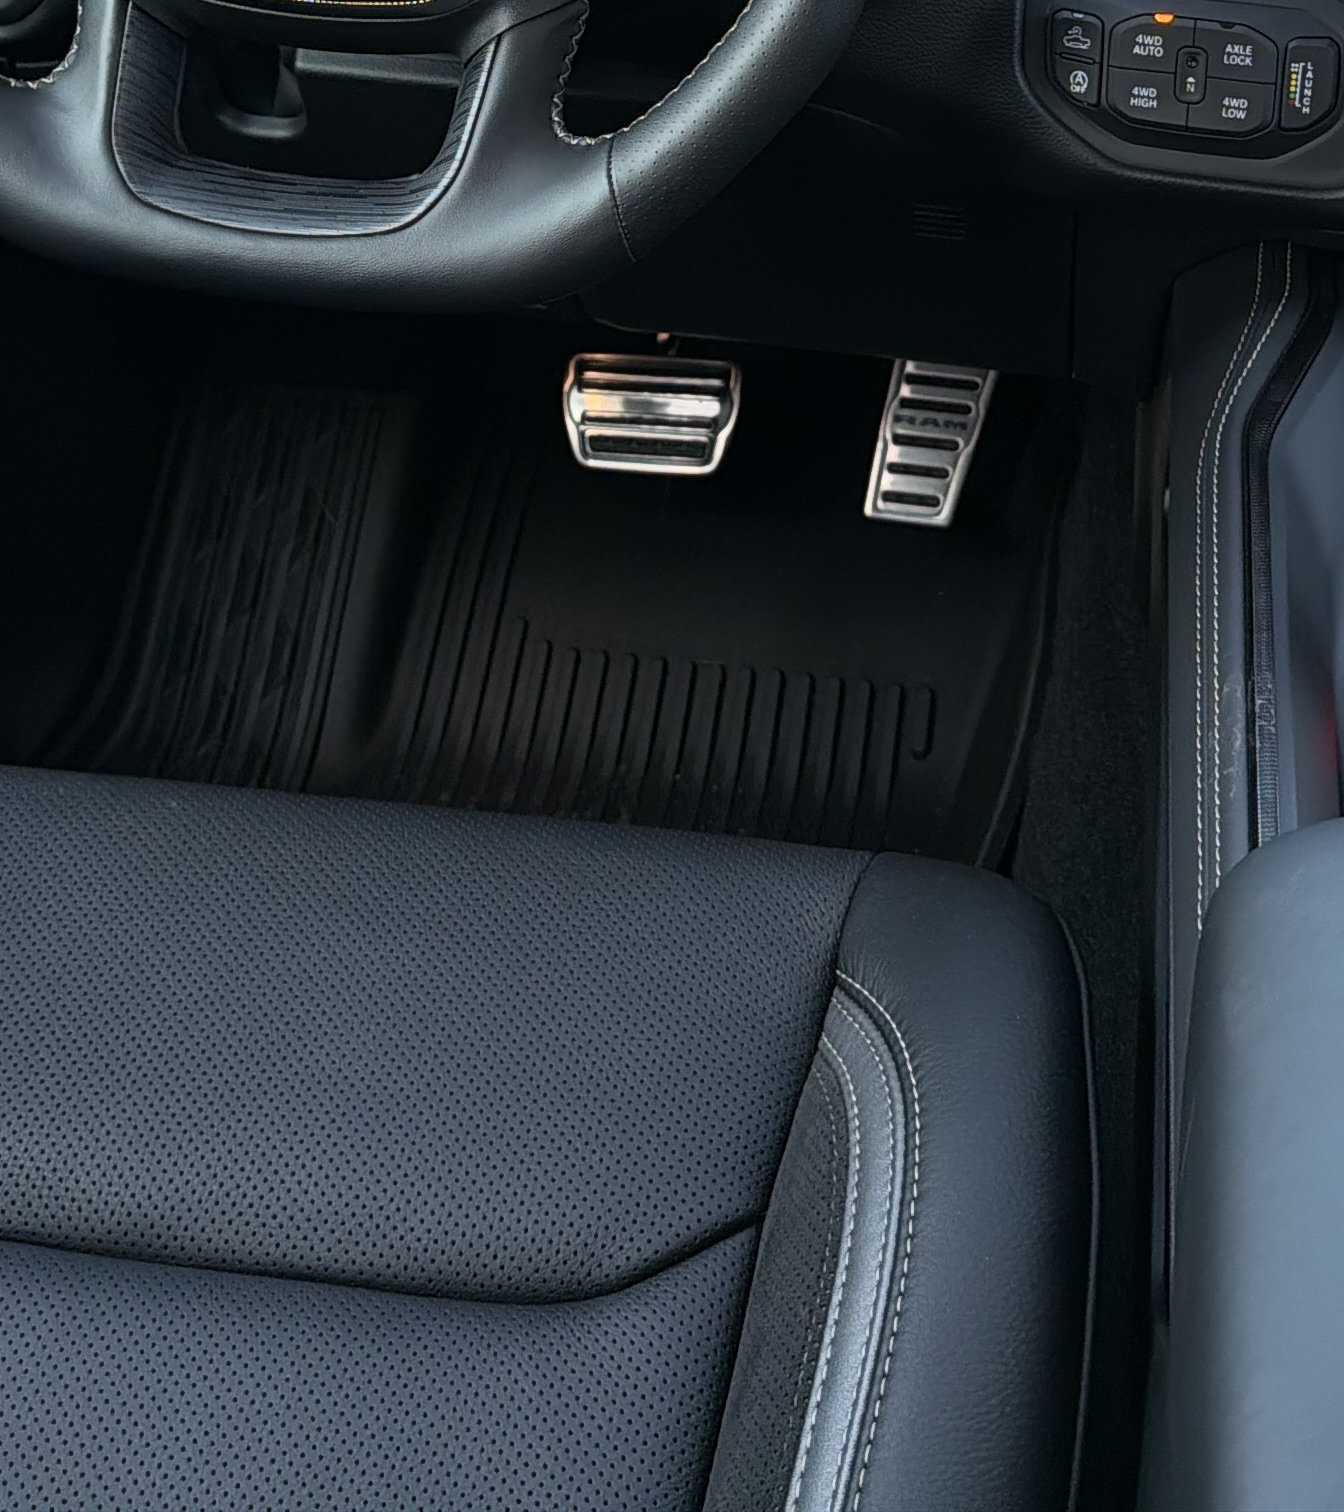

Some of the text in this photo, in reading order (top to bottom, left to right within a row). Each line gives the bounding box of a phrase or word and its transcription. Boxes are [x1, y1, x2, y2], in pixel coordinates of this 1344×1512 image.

[1135, 33, 1163, 46] 4WD
[1132, 45, 1164, 58] AUTO
[1224, 43, 1253, 56] AXLE
[1223, 54, 1253, 67] LOCK
[1131, 86, 1157, 98] 4WD
[1129, 96, 1158, 109] HIGH
[1222, 97, 1248, 109] 4WD
[1221, 107, 1248, 119] LOW
